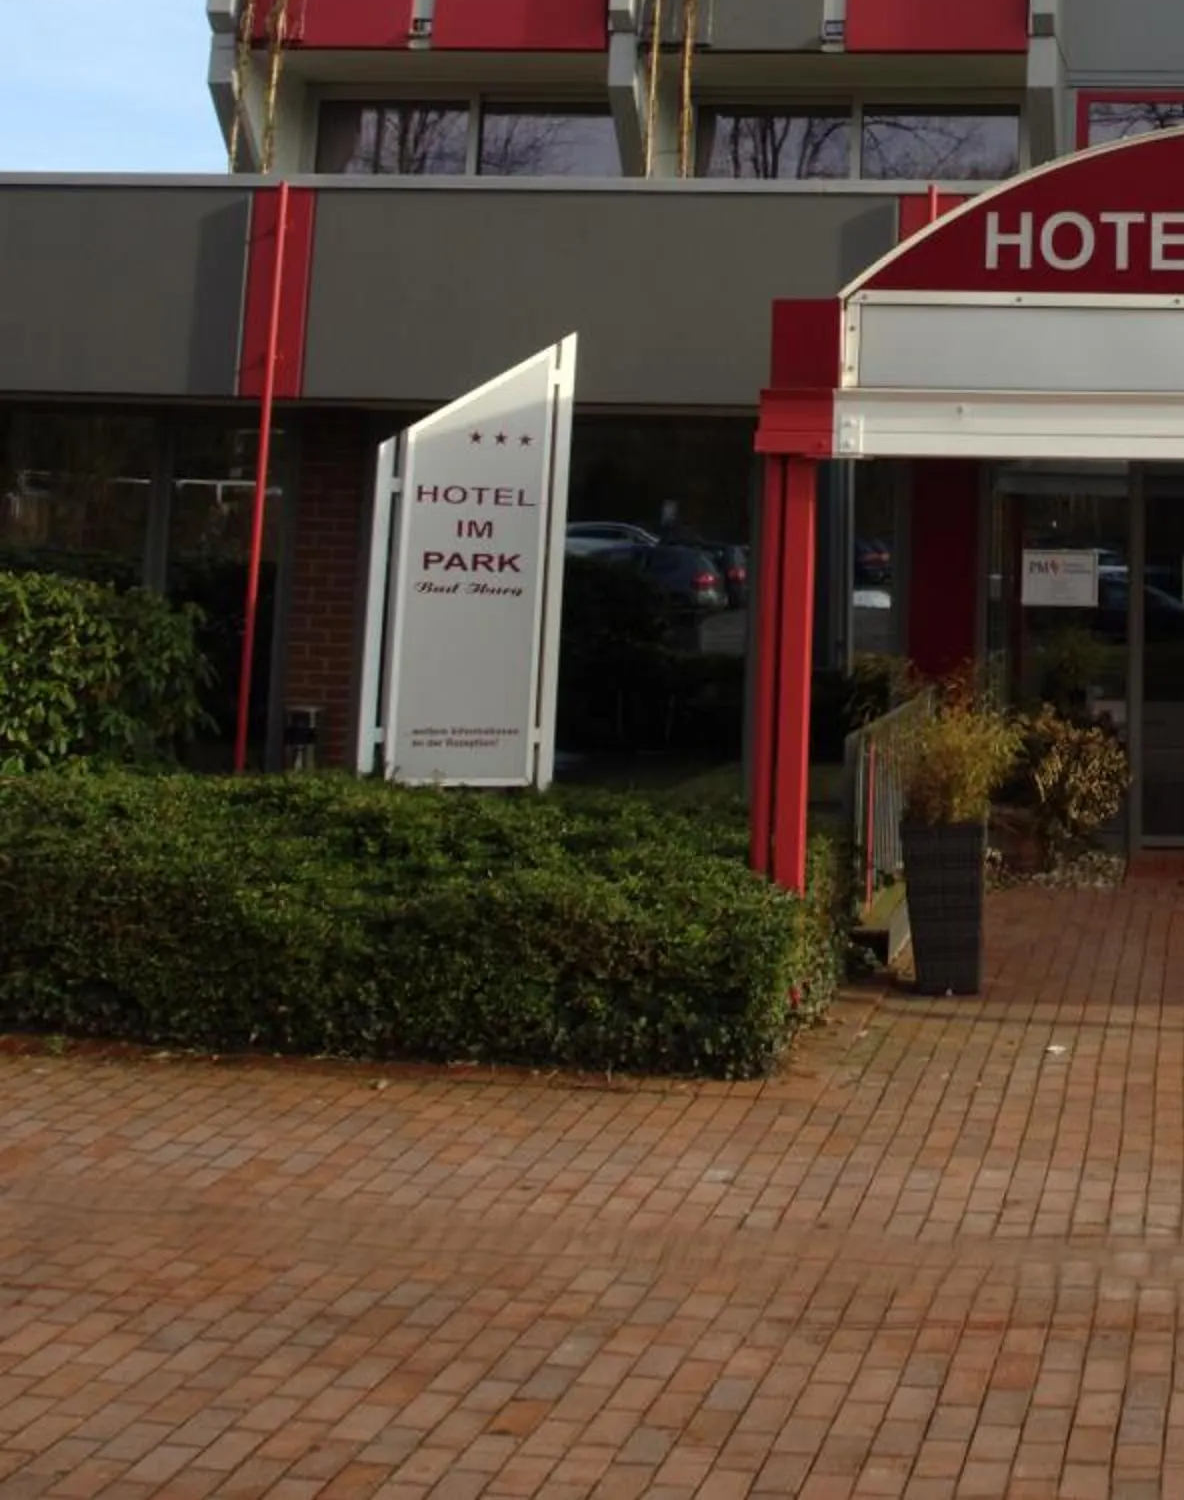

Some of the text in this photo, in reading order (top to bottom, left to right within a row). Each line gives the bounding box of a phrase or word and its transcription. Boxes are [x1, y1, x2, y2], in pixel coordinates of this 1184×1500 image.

[416, 485, 537, 507] HOTEL
[457, 519, 493, 538] IM
[423, 552, 522, 573] PARK
